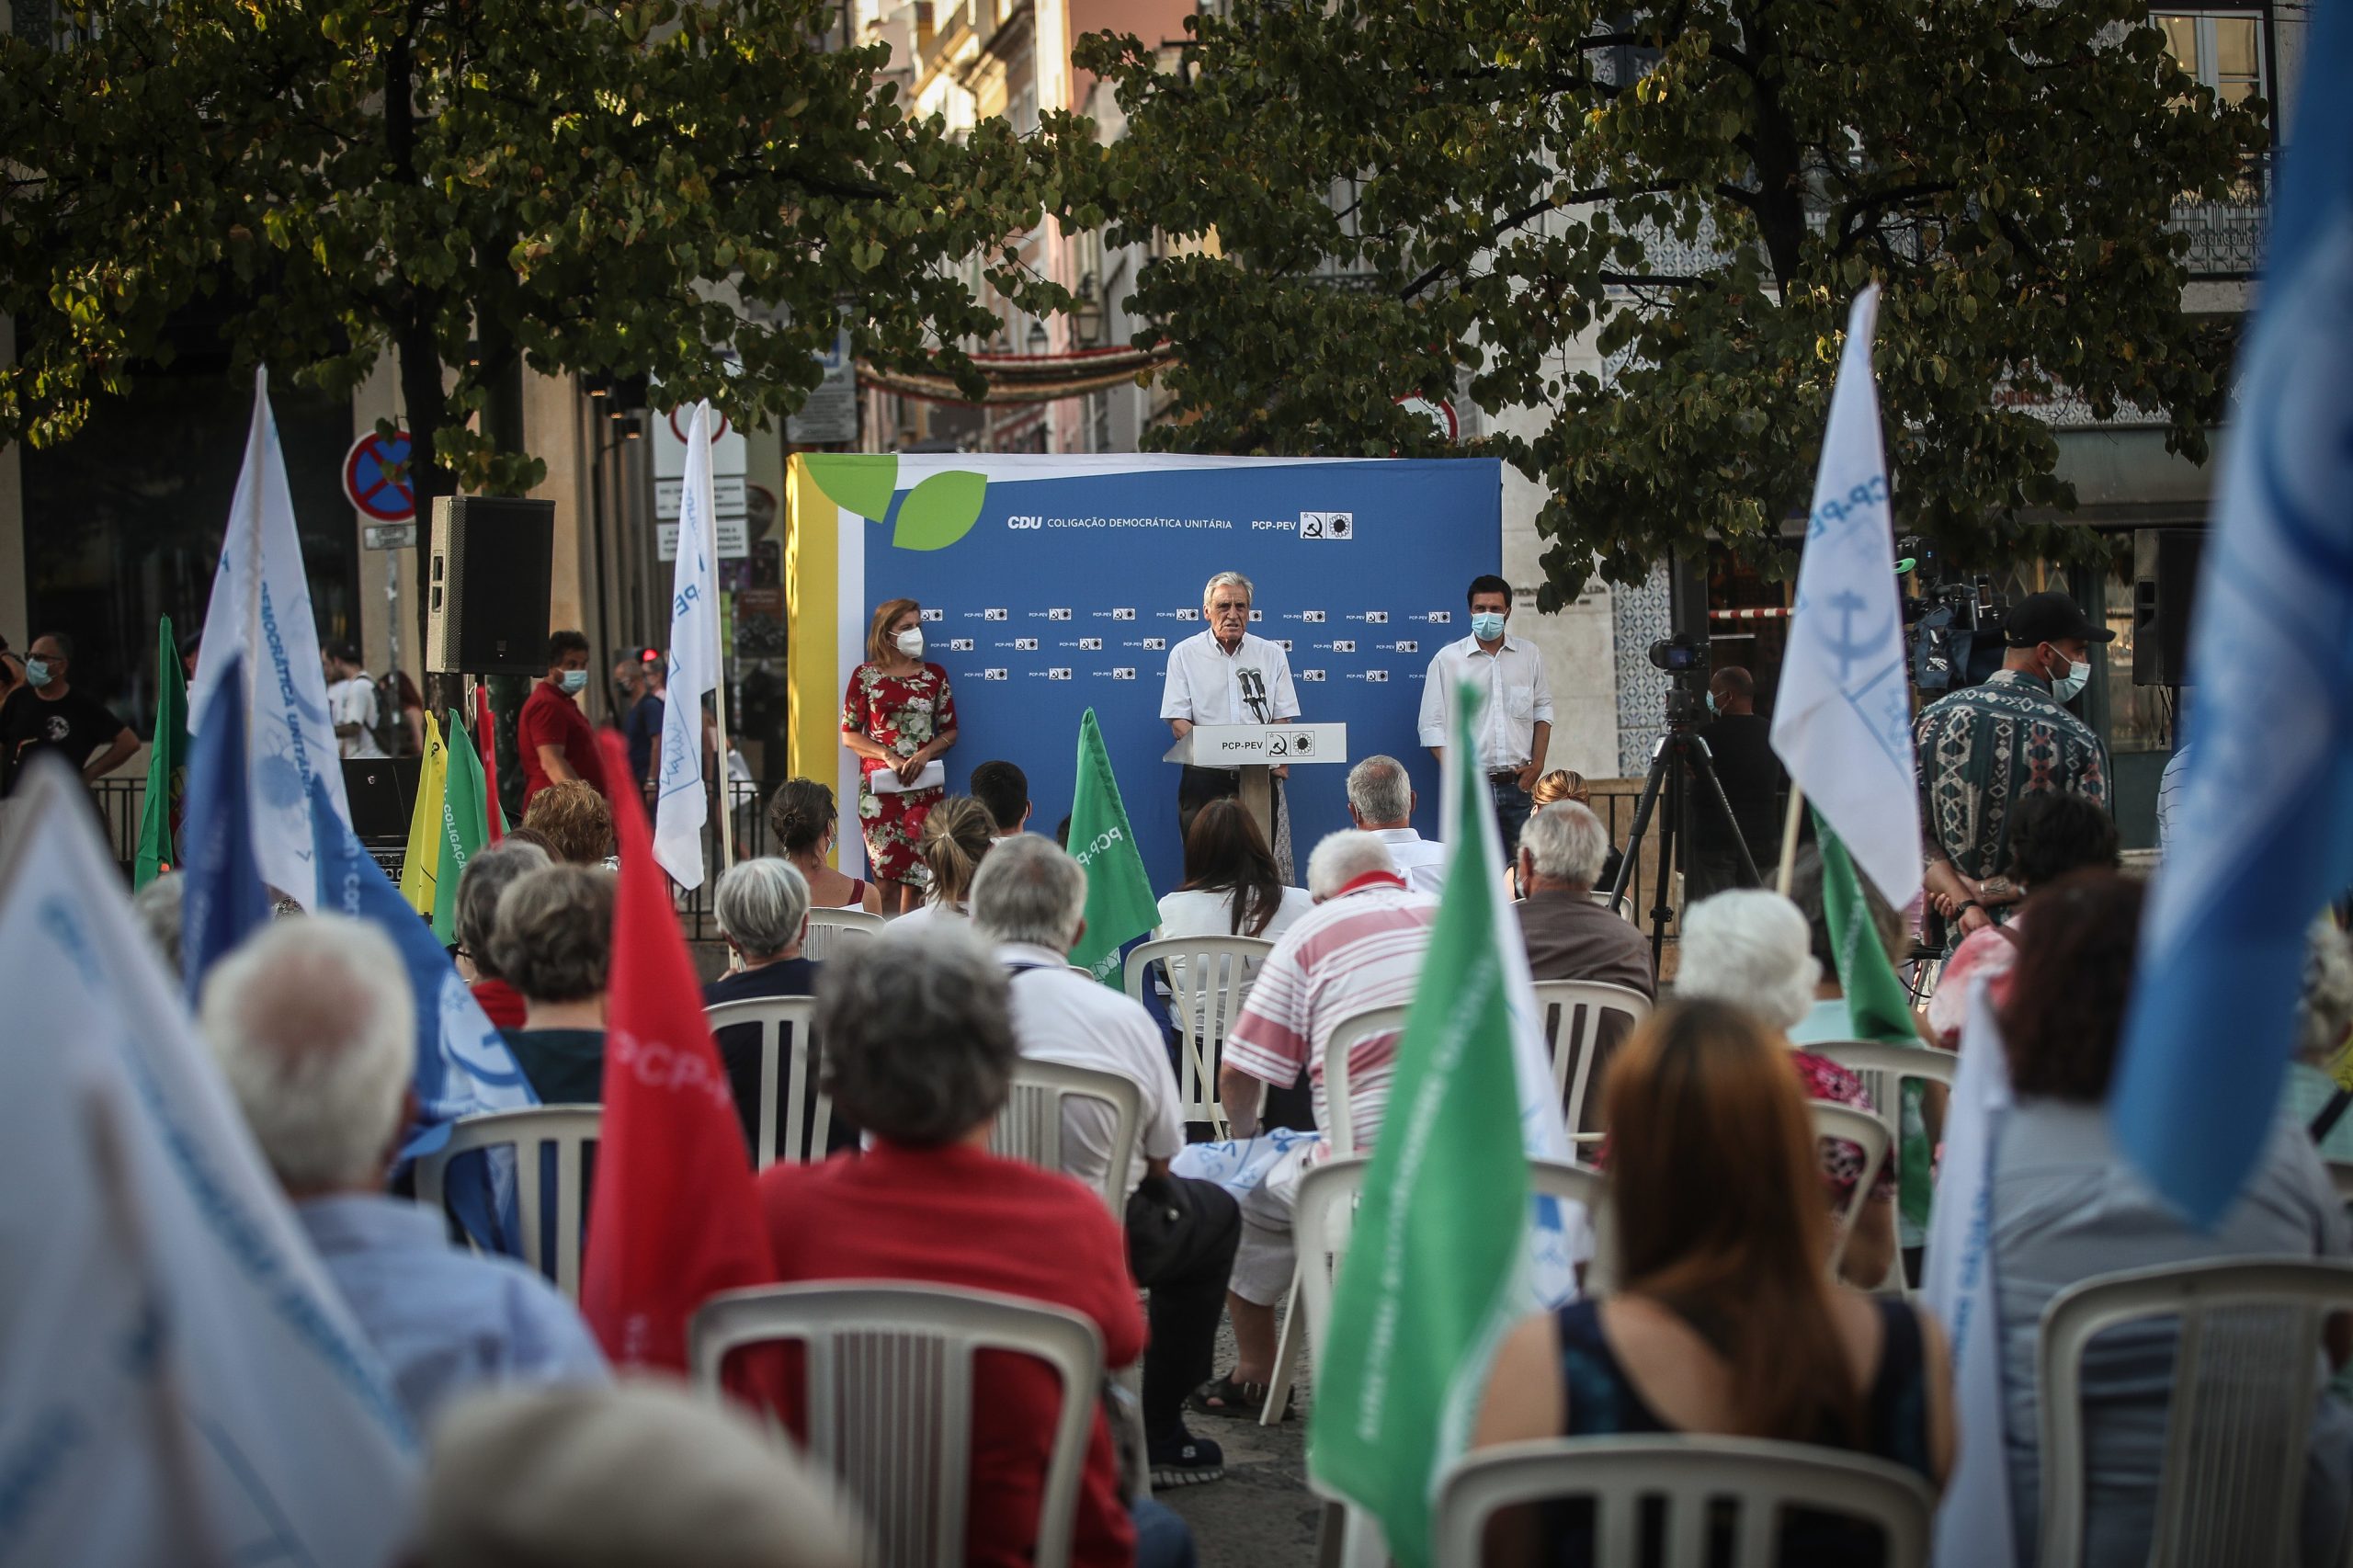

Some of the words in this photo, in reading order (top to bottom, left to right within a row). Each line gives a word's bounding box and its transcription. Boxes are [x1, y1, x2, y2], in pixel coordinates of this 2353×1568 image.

[1007, 516, 1043, 530] CDU
[1047, 517, 1106, 528] COLIGAÇÃO
[1108, 517, 1182, 528] DEMOCRÁTICA
[1184, 517, 1233, 529] UNITÁRIA
[1251, 520, 1297, 530] PCP-PEV
[1222, 741, 1263, 750] PCP-PEV
